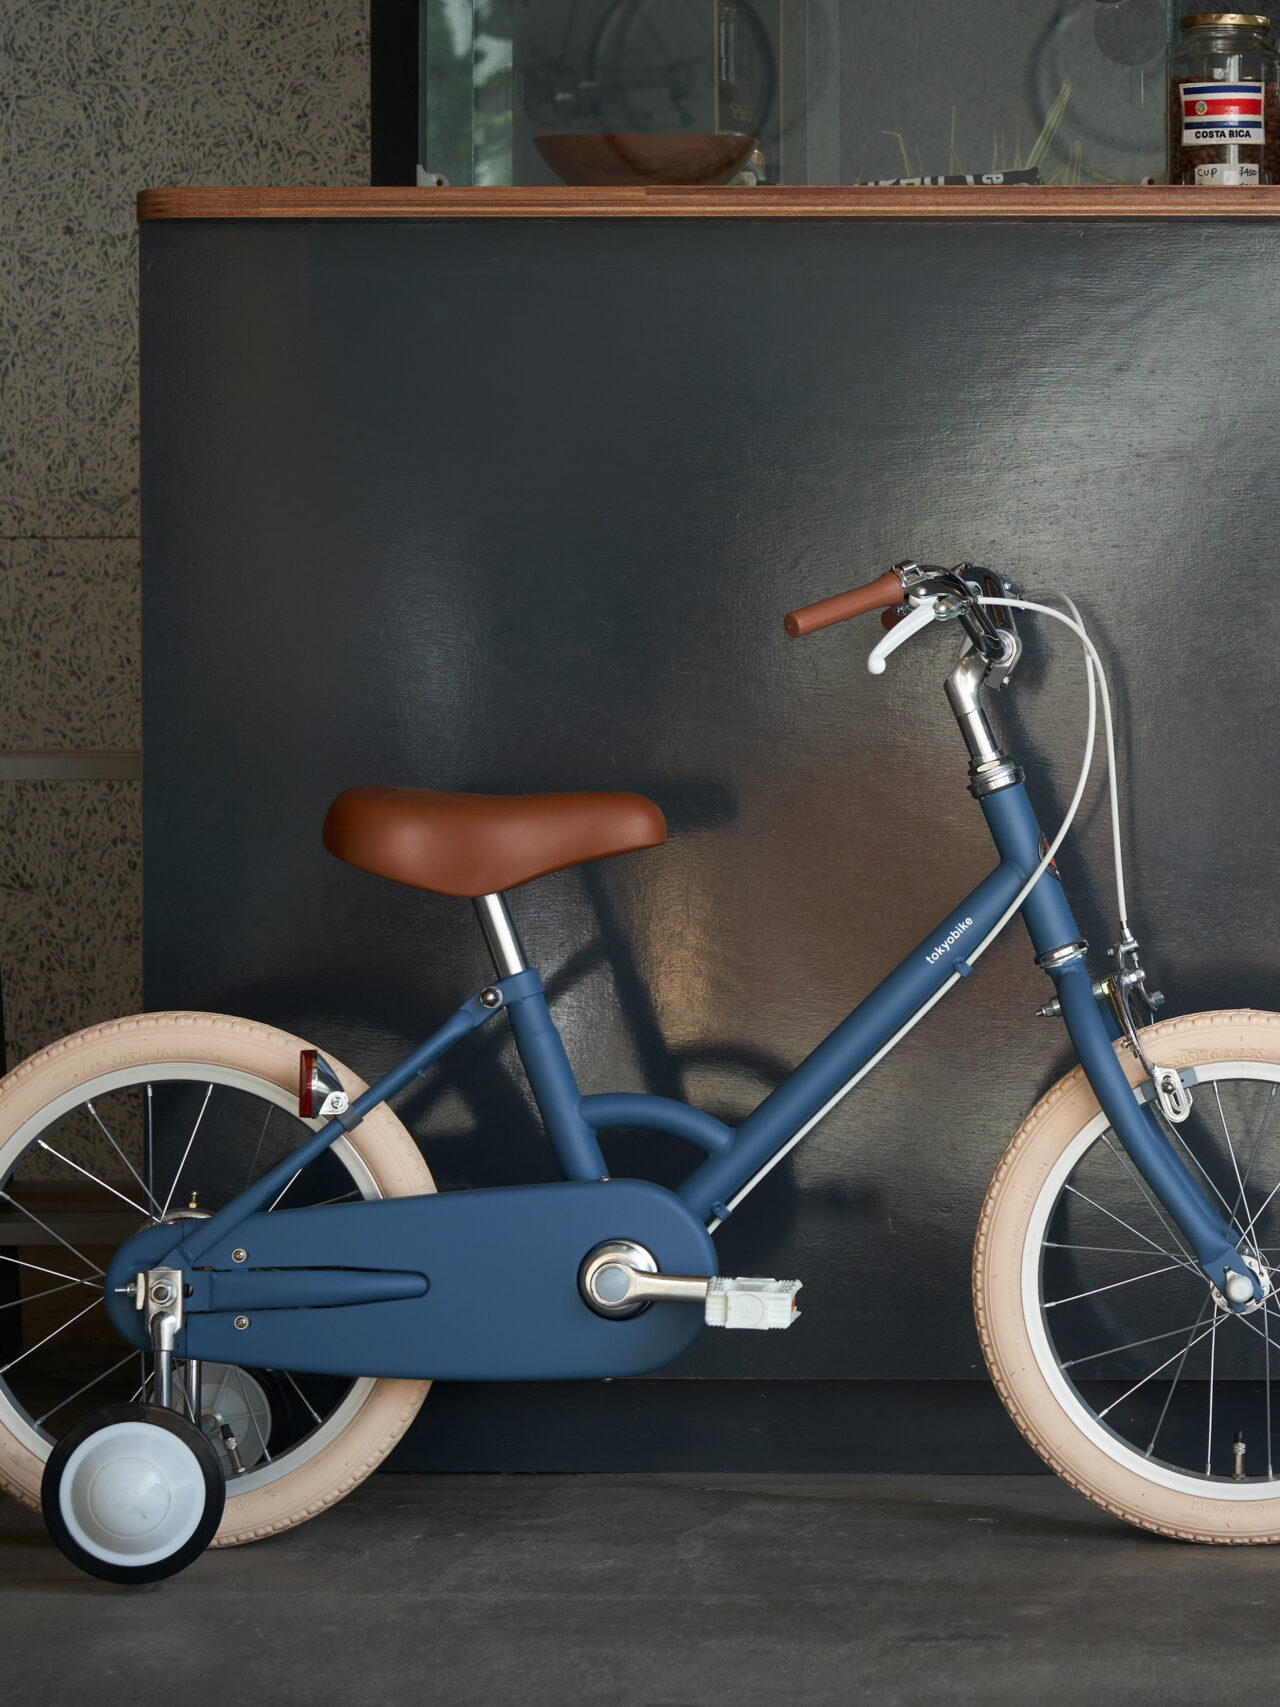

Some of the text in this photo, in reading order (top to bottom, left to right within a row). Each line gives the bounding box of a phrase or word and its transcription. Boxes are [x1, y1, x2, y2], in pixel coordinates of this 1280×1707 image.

[1194, 129, 1252, 139] COSTA RICA
[925, 916, 974, 965] tokyobike
